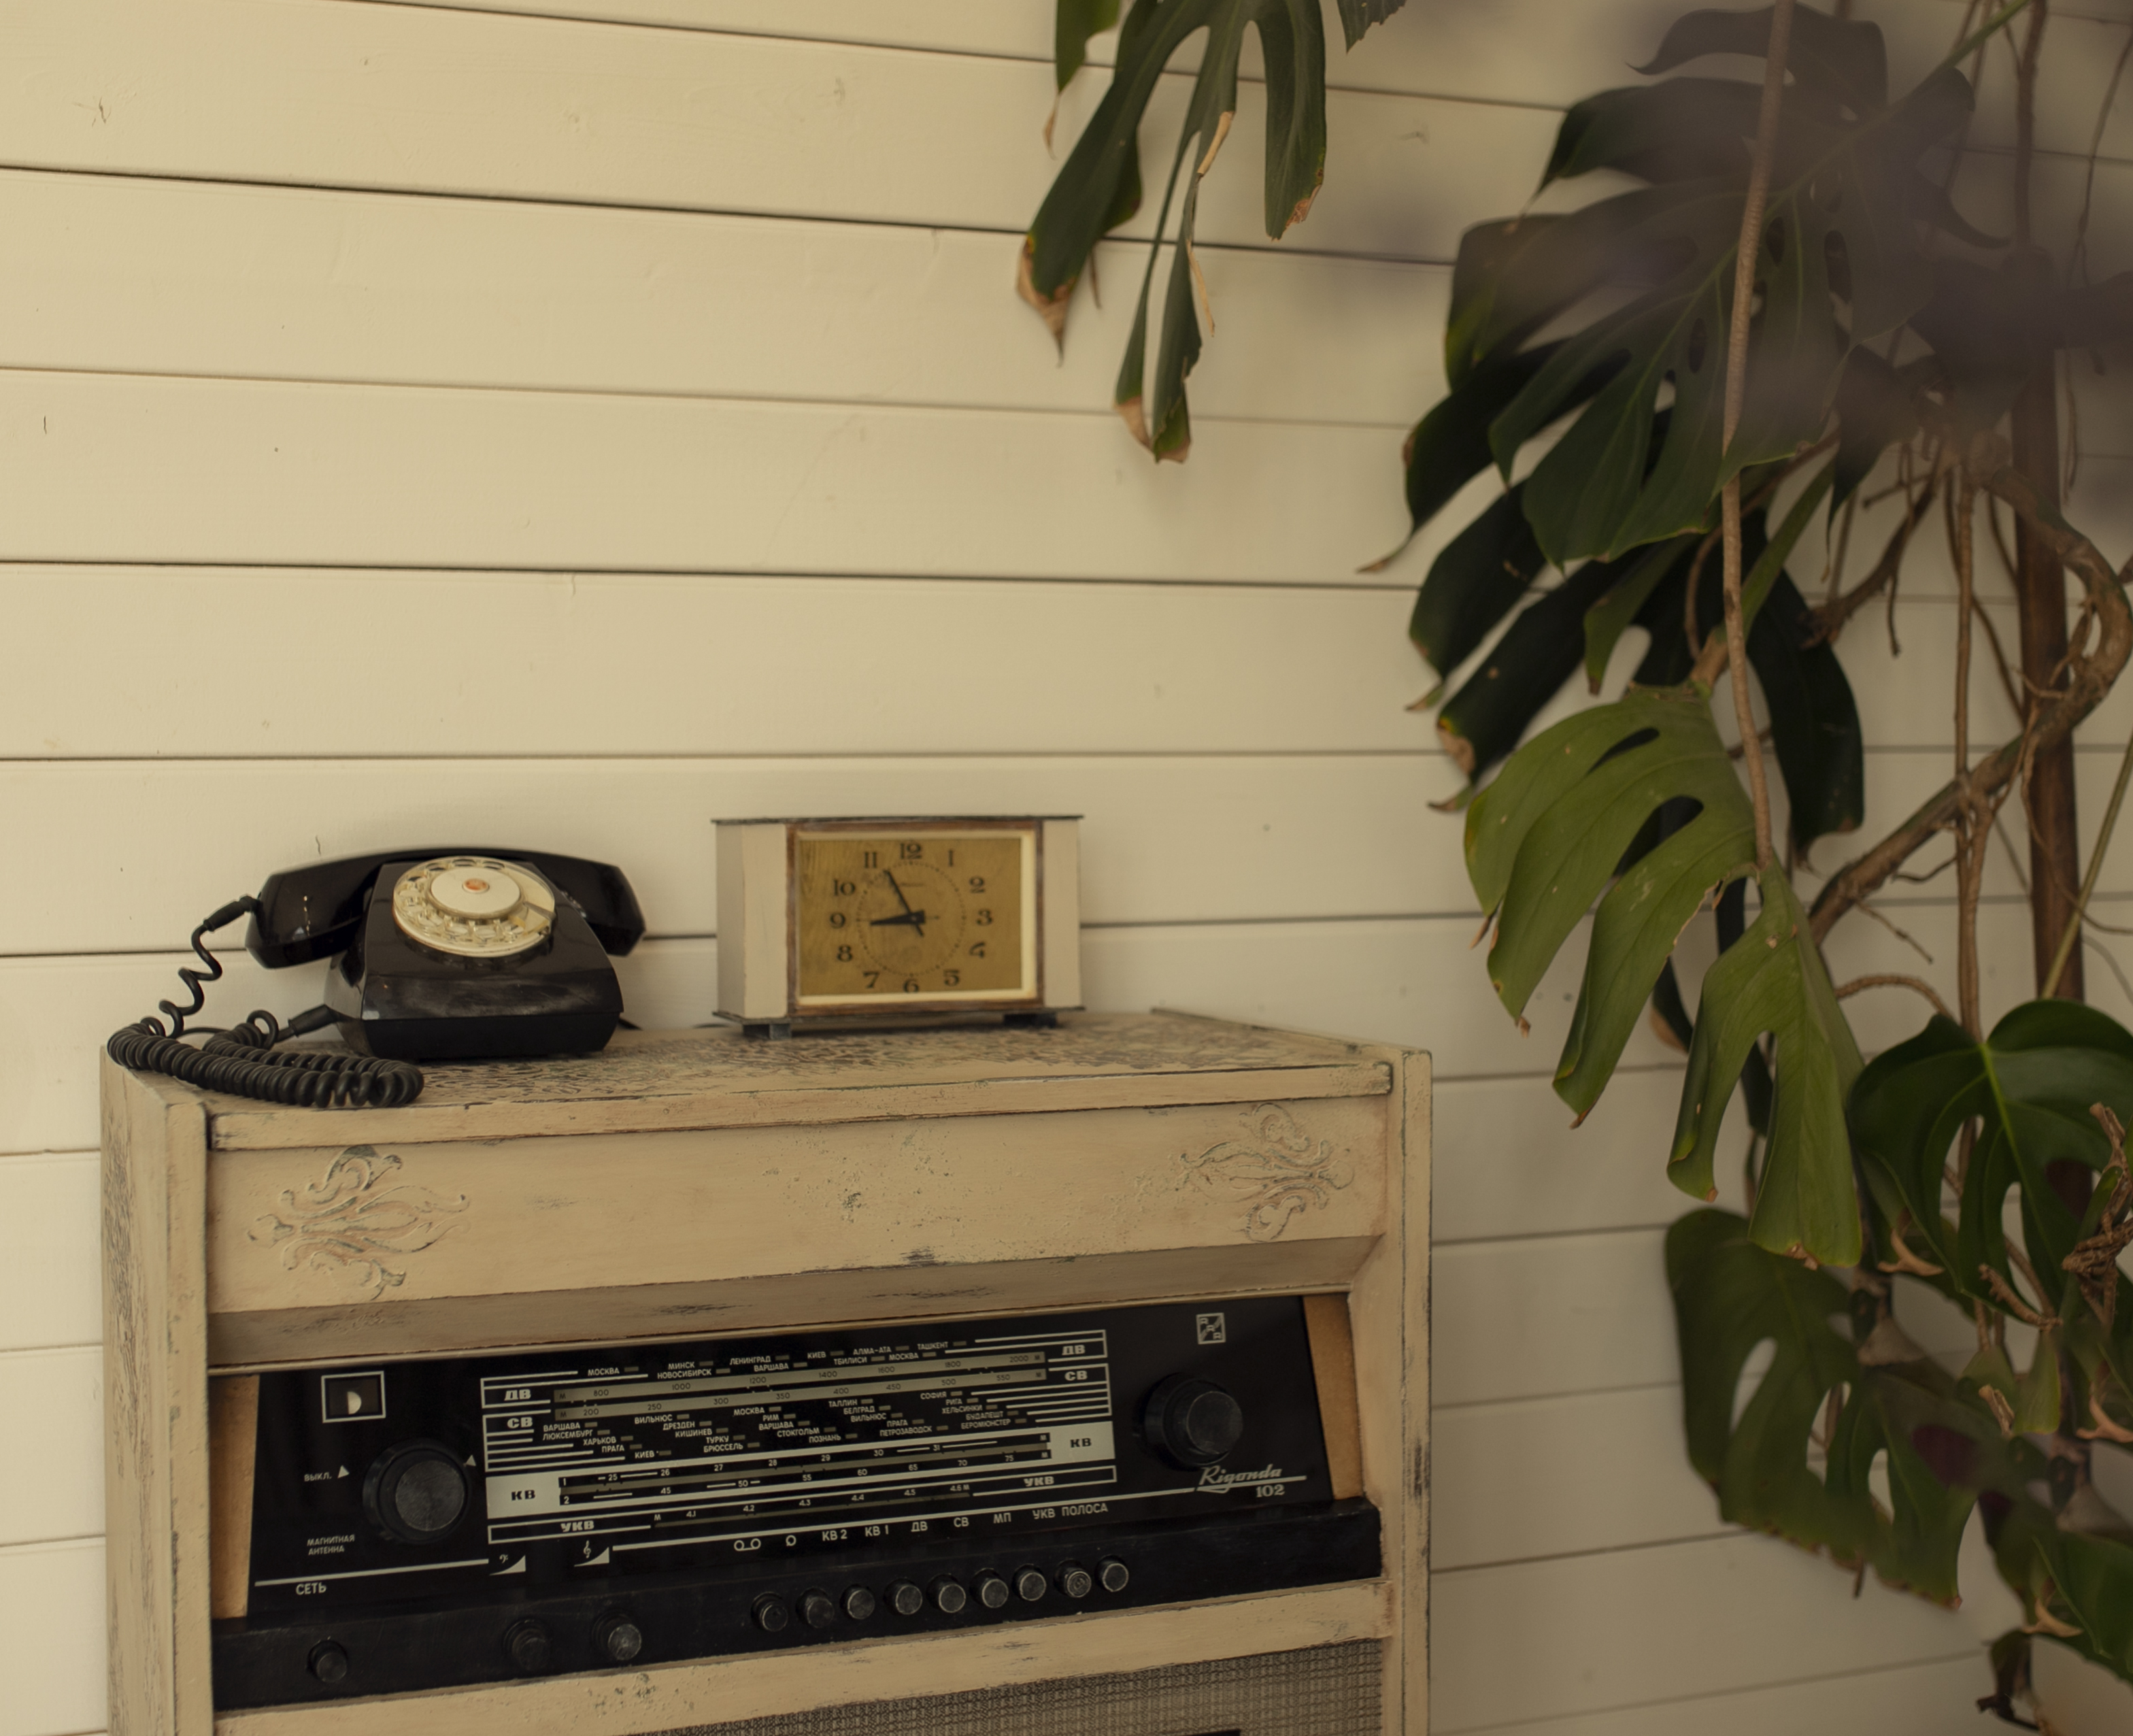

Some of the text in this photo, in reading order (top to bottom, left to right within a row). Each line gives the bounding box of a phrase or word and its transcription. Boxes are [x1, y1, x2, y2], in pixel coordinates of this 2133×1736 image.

[900, 843, 922, 860] 12
[833, 879, 856, 897] 10
[969, 876, 986, 894] 2
[830, 913, 845, 929] 9
[976, 909, 993, 926] 3
[837, 945, 853, 962] 8
[969, 941, 986, 958] 4
[863, 971, 880, 988] 7
[943, 969, 960, 986] 5
[903, 978, 920, 993] 6
[853, 1346, 892, 1355] АЛМА-АТА
[917, 1341, 948, 1350] ТАШКЕНТ
[1062, 1345, 1086, 1356] ДВ
[730, 1356, 771, 1365] ЛЕНИНГРАД
[807, 1351, 826, 1359] КИЕВ
[833, 1356, 867, 1365] ТБИЛИСИ
[889, 1352, 919, 1361] МОСКВА
[588, 1367, 620, 1376] МОСКВА
[668, 1362, 695, 1370] МИНСК
[754, 1363, 789, 1372] ВАРШАВА
[657, 1369, 711, 1380] НОВОСИБИРСК
[1064, 1370, 1088, 1381] СВ
[504, 1388, 531, 1401] ДВ
[920, 1391, 947, 1399] СОФИЯ
[828, 1399, 858, 1407] ТАЛЛИН
[584, 1408, 599, 1416] 200
[733, 1407, 765, 1416] МОСКВА
[843, 1406, 875, 1415] БЕЛГРАД
[966, 1411, 1003, 1420] БУДАПЕШТ
[507, 1417, 533, 1429] СВ
[635, 1414, 673, 1424] ВИЛЬНЮС
[851, 1413, 886, 1422] ВИЛЬНЮС
[543, 1422, 580, 1432] ВАРШАВА
[663, 1421, 695, 1431] ДРЕЗДЕН
[758, 1421, 794, 1431] ВАРШАВА
[675, 1429, 712, 1438] КИШИНЕВ
[809, 1435, 841, 1443] ПОЗНАНЬ
[583, 1437, 616, 1446] ХАРЬКОВ
[706, 1436, 729, 1444] ТУРКУ
[1070, 1438, 1092, 1448] КВ
[602, 1445, 624, 1453] ПРАГА
[703, 1443, 743, 1453] БРЮССЕЛЬ
[635, 1450, 655, 1459] КИЕВ
[608, 1473, 618, 1482] 25
[660, 1469, 670, 1477] 26
[1198, 1464, 1283, 1492] Rigonda
[1024, 1476, 1054, 1487] УКВ
[511, 1490, 536, 1501] КВ
[1256, 1484, 1285, 1498] 102
[564, 1497, 569, 1505] 2
[1032, 1503, 1108, 1519] УКВ ПОЛОСА
[953, 1517, 969, 1528] СВ
[993, 1513, 1011, 1524] МП
[560, 1520, 594, 1533] УКВ
[864, 1525, 881, 1537] КВ
[911, 1521, 928, 1532] ДВ
[307, 1534, 355, 1546] МАГНИТНАЯ
[822, 1529, 848, 1541] КВ 2
[308, 1545, 344, 1556] АНТЕННА
[296, 1583, 326, 1595] СЕТЬ
